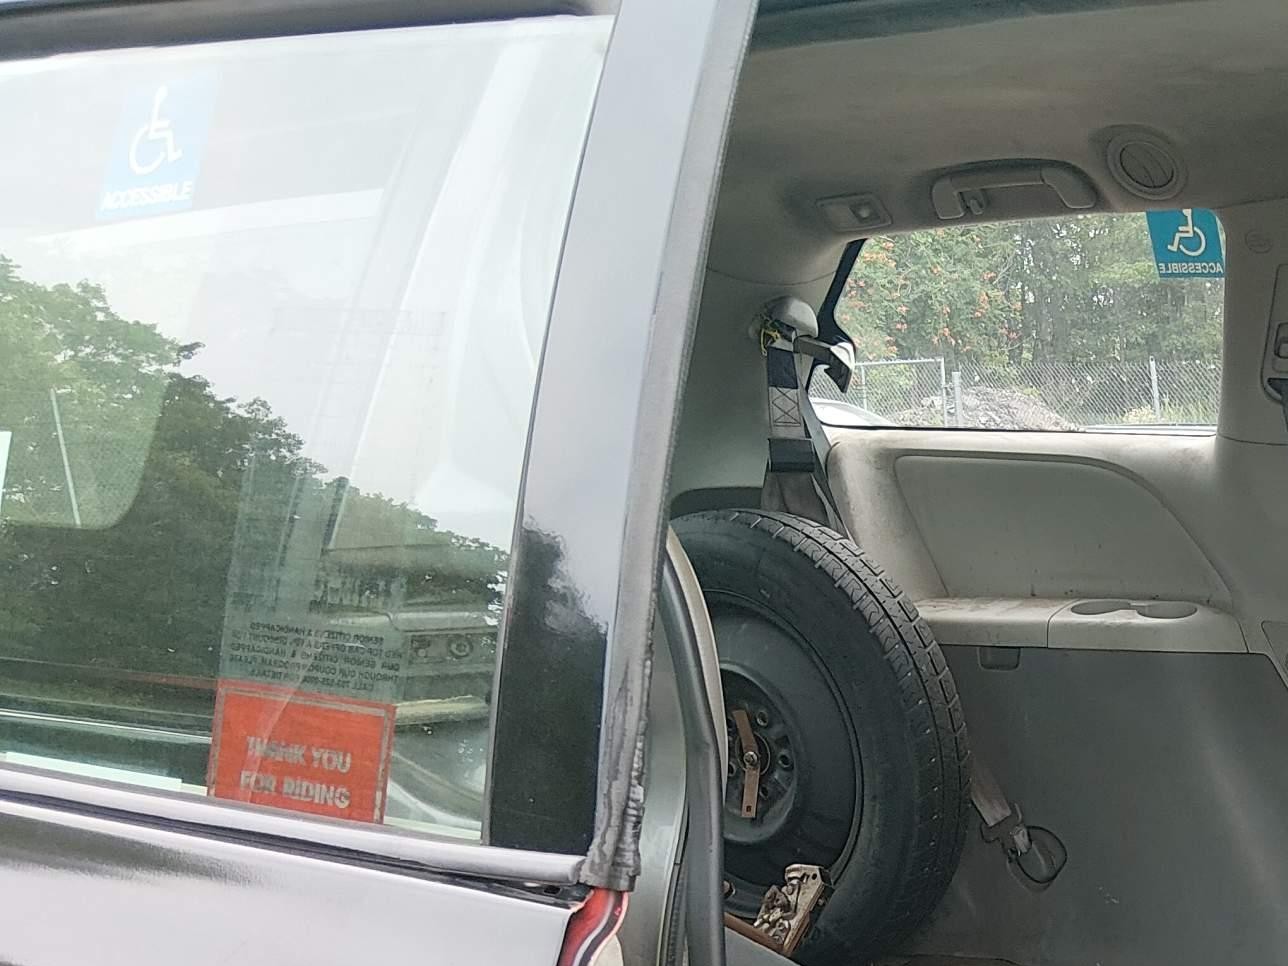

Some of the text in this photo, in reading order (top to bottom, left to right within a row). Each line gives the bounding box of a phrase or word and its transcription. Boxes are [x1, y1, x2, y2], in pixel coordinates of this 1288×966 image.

[101, 181, 193, 210] ACCESSIBLE
[246, 735, 352, 774] THANK YOU
[240, 770, 351, 809] FOR RIDING
